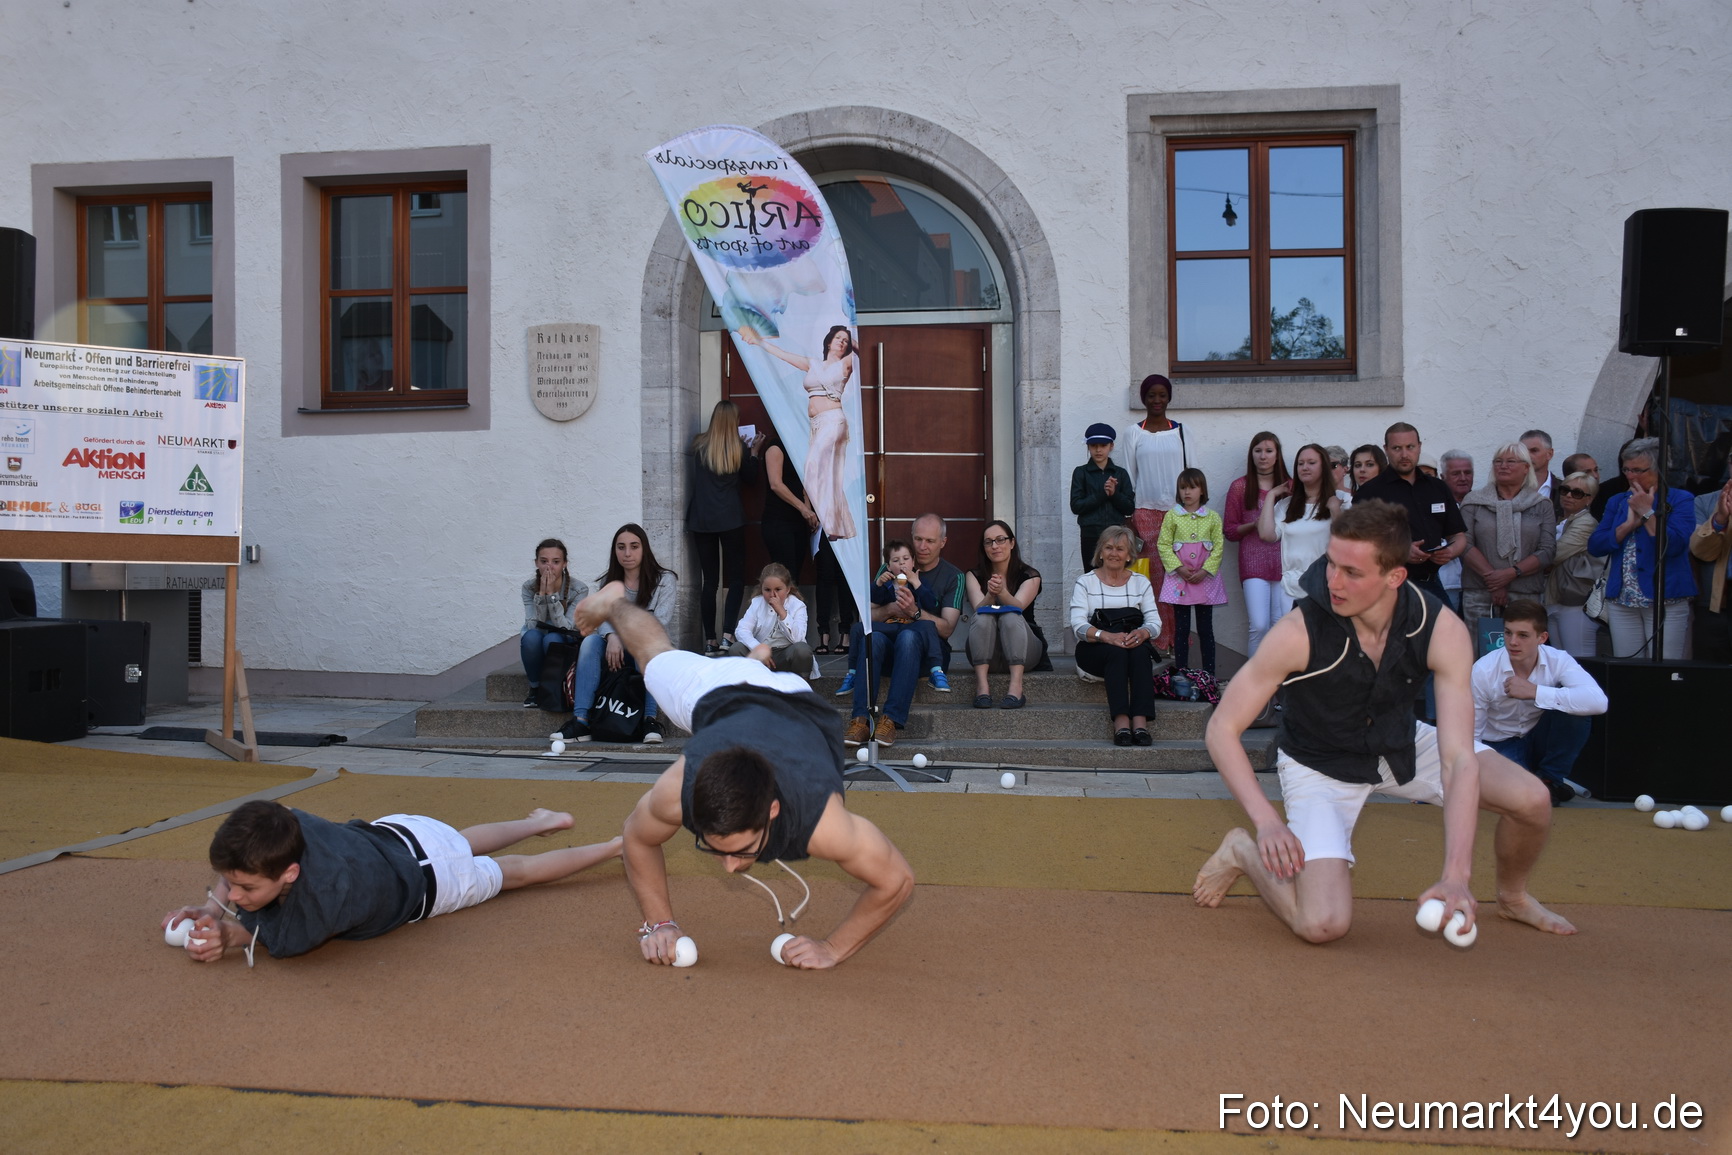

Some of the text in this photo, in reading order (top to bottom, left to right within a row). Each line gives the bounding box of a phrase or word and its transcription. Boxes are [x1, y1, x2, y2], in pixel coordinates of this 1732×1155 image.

[537, 333, 589, 344] Rathaus
[25, 347, 76, 362] Neumarkt
[85, 352, 112, 365] Offen
[115, 355, 133, 367] und
[136, 356, 191, 371] Barrierefrei
[40, 362, 83, 371] Europäischer
[85, 365, 119, 374] Protesttag
[132, 369, 176, 379] Gleichstellung
[73, 374, 105, 382] Menschen
[119, 377, 158, 386] Behinderung
[34, 379, 181, 397] Arbeitsgemeinschaft Offene Behindertenarbeit
[43, 404, 83, 412] unserer
[87, 407, 129, 417] sozialen
[132, 408, 163, 418] Arbeit
[158, 435, 225, 448] NEUMARKT
[98, 470, 145, 480] MENSCH
[148, 508, 213, 518] Dienstleistungen
[166, 576, 225, 589] RATHAUSPLATZ
